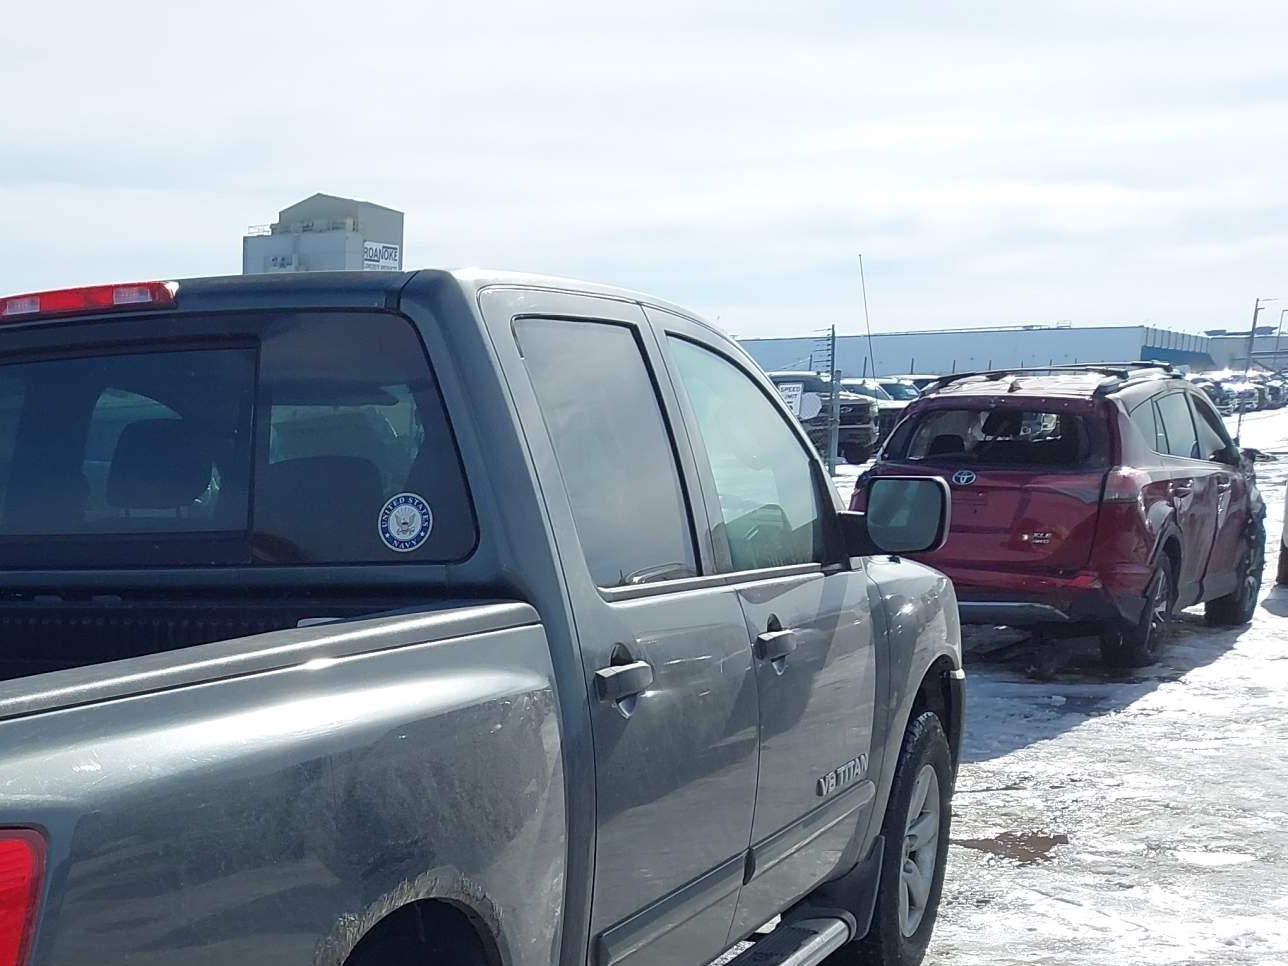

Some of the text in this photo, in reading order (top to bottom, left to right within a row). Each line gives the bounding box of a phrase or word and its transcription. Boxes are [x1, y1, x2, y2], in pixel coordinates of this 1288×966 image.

[363, 247, 398, 261] ROANOKE
[382, 497, 429, 528] UNITED STATES
[393, 539, 417, 549] NAVY
[816, 751, 869, 796] V8 TITAN
